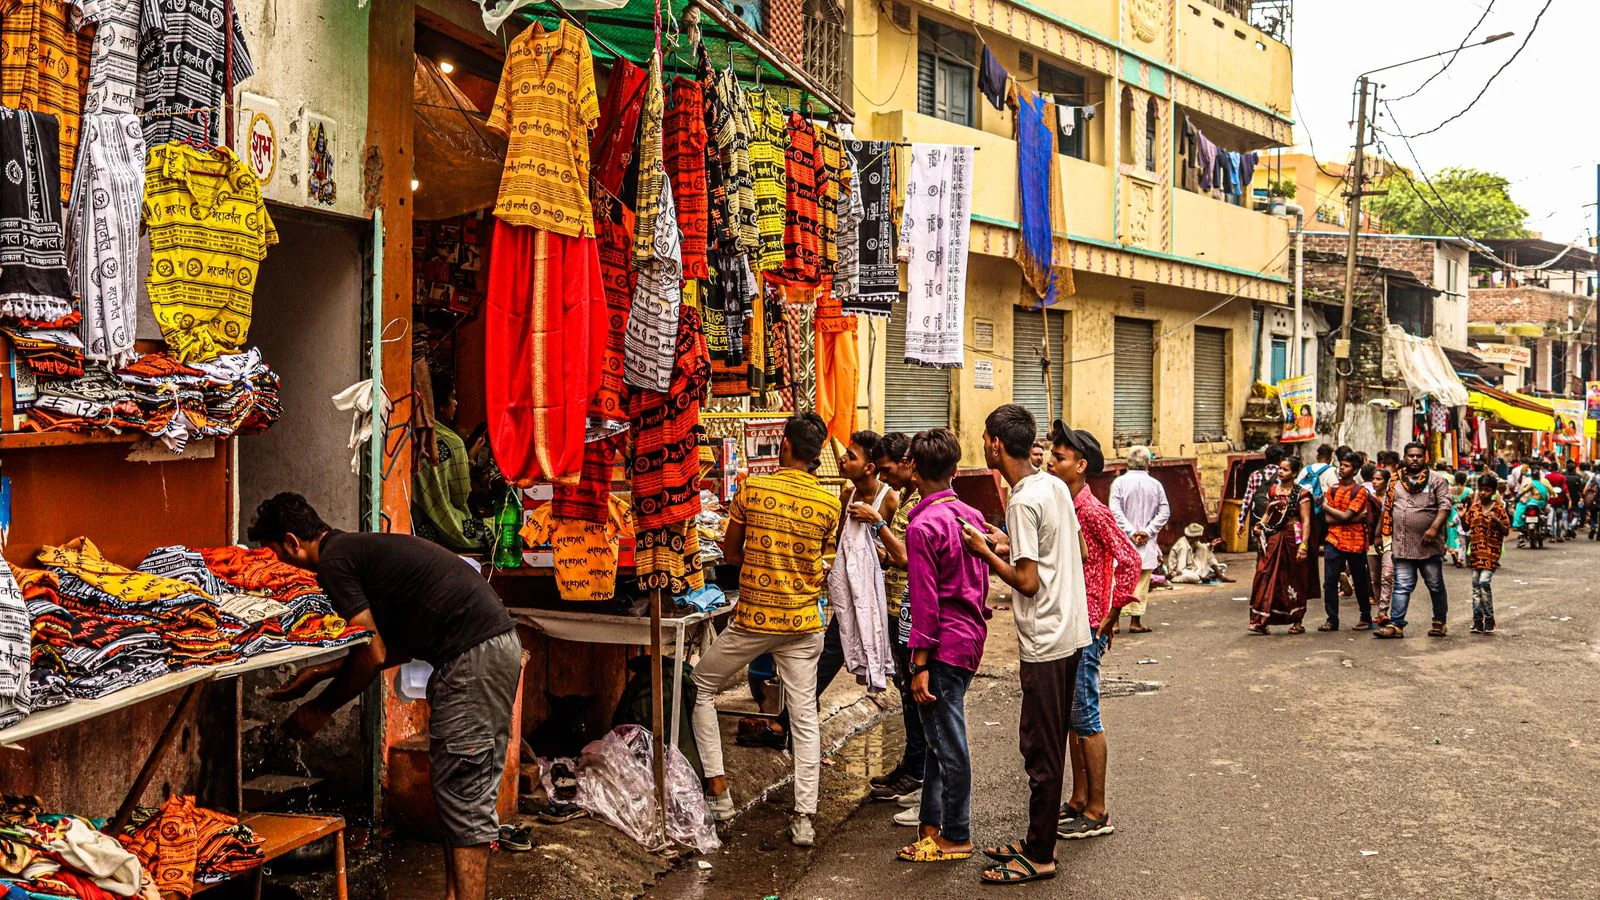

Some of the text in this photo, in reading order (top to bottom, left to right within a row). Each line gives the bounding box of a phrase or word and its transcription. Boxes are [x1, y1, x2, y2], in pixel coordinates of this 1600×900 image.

[252, 131, 273, 174] शुभ
[96, 217, 117, 251] महाकाल
[207, 260, 236, 280] महाकाल
[750, 429, 784, 437] GALAX
[779, 500, 799, 513] महाकाल
[769, 613, 790, 625] महाकाल
